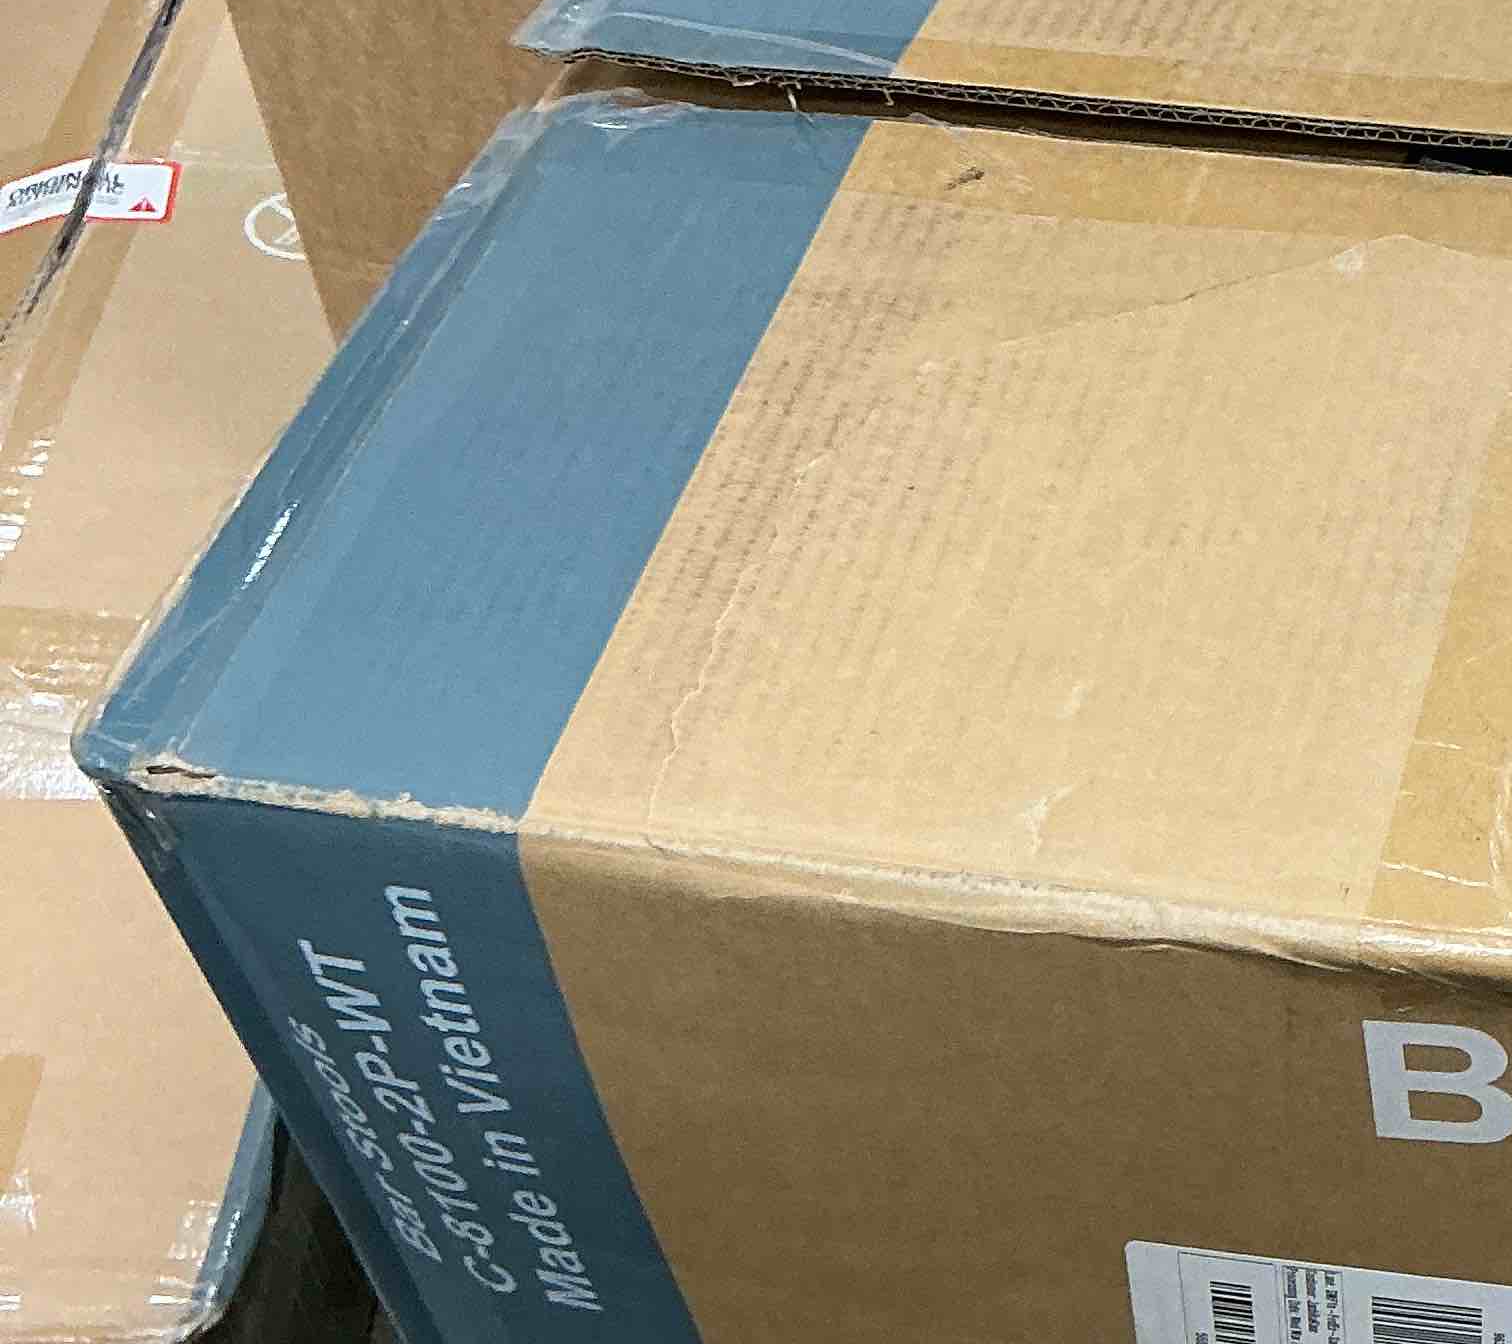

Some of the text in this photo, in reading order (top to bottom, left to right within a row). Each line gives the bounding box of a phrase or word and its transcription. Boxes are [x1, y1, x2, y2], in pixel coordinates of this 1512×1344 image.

[298, 938, 518, 1295] C-8100-2P-WT
[384, 885, 603, 1312] Made in Vietnam
